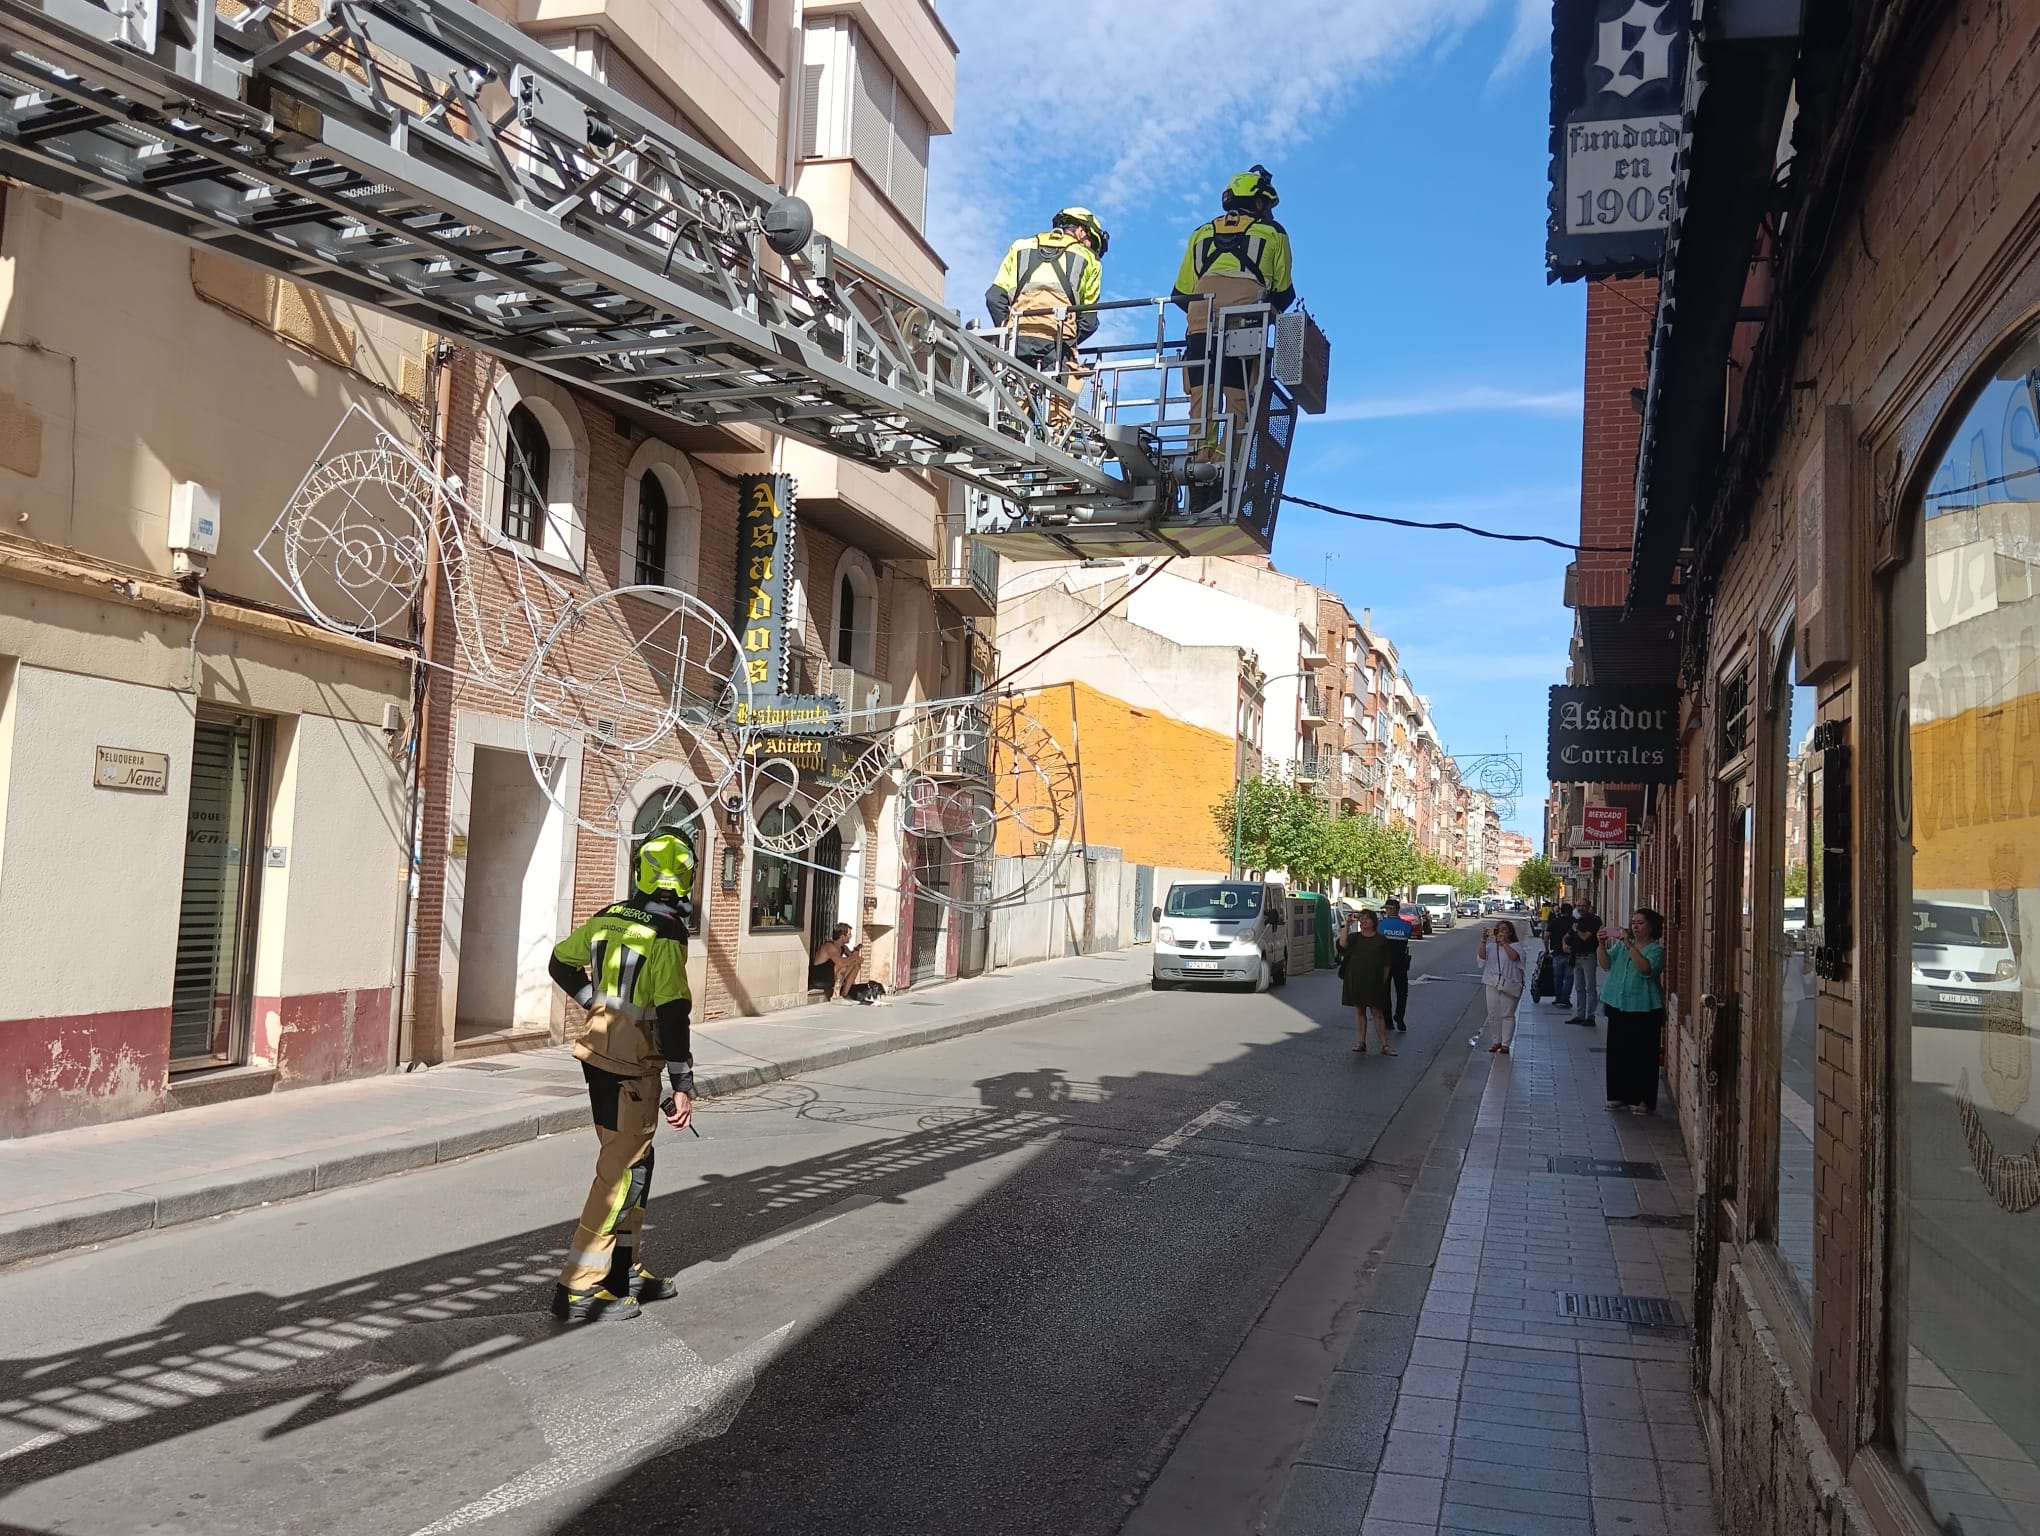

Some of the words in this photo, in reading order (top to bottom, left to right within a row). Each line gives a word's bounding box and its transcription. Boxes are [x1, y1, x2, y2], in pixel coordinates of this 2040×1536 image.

[1570, 121, 1680, 157] fundad
[1614, 156, 1651, 180] en
[743, 482, 782, 684] Asados
[1560, 701, 1667, 730] Asador
[765, 738, 821, 753] Abierto
[1561, 744, 1664, 765] Corrales
[100, 751, 145, 766] PELUQUERIA
[119, 767, 162, 788] Neme
[1588, 811, 1622, 819] MERCADO
[1600, 820, 1610, 828] DE
